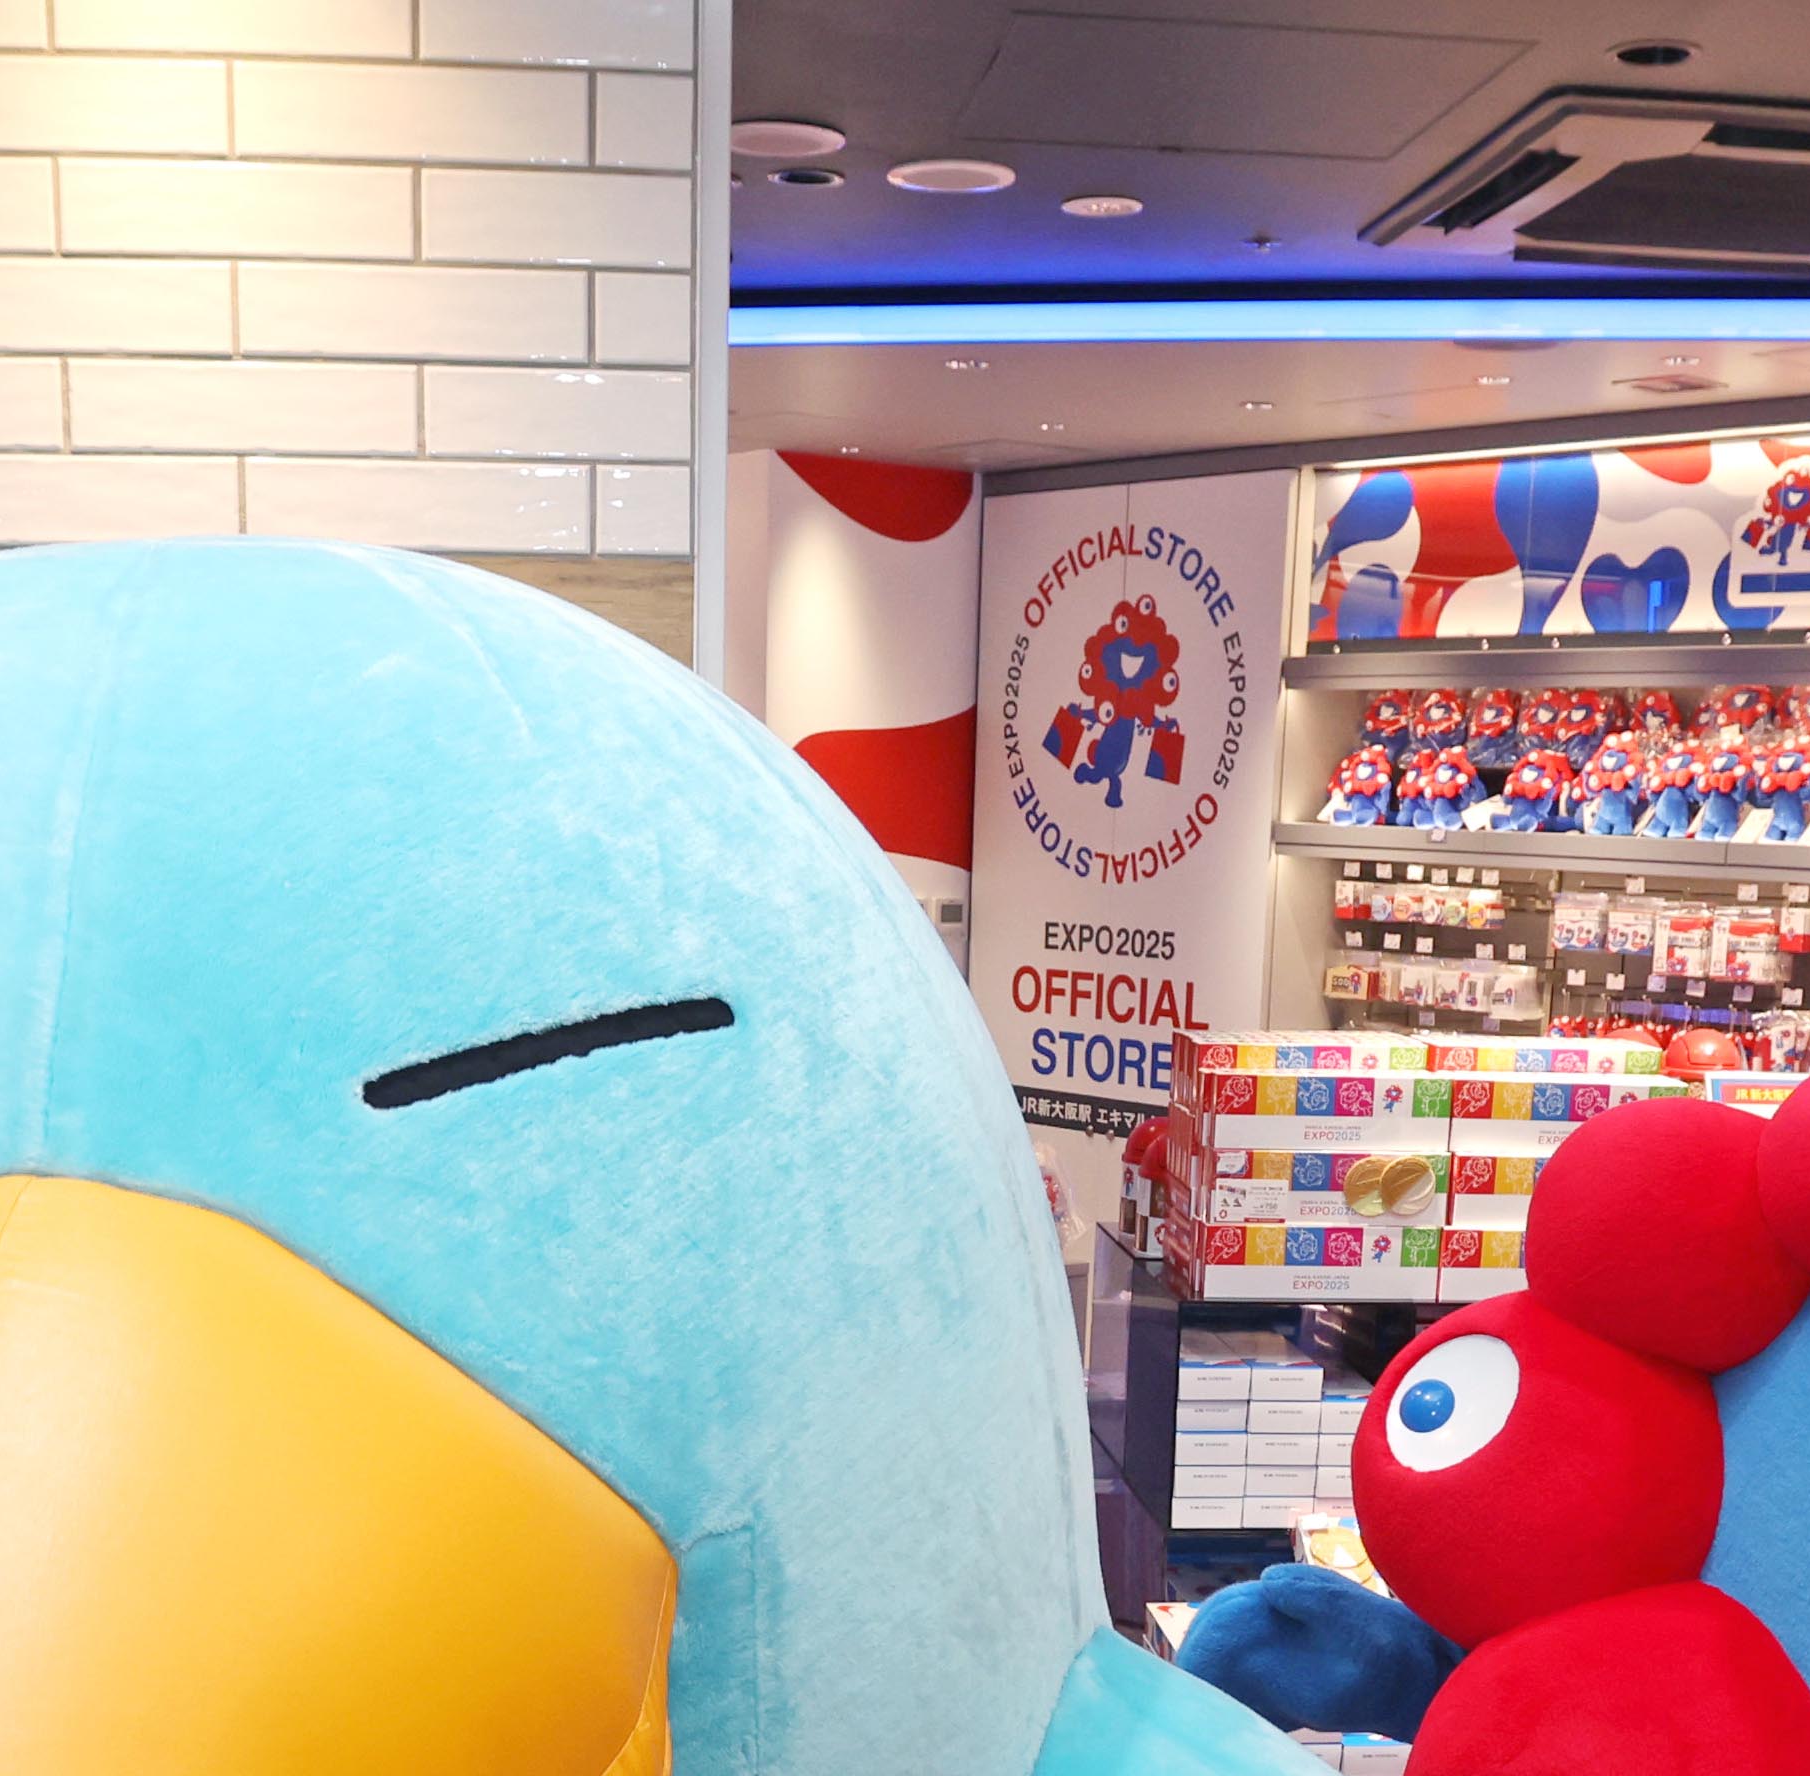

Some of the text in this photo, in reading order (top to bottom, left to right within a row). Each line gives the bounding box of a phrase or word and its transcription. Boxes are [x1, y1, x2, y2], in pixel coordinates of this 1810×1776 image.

[1044, 921, 1176, 961] EXPO2025
[1012, 965, 1209, 1031] OFFICIAL
[1031, 1027, 1173, 1091] STORE
[1022, 1096, 1155, 1130] JR新大阪駅 エキマル
[1304, 1131, 1361, 1141] EXPO2025
[1293, 1280, 1350, 1290] EXPO2025
